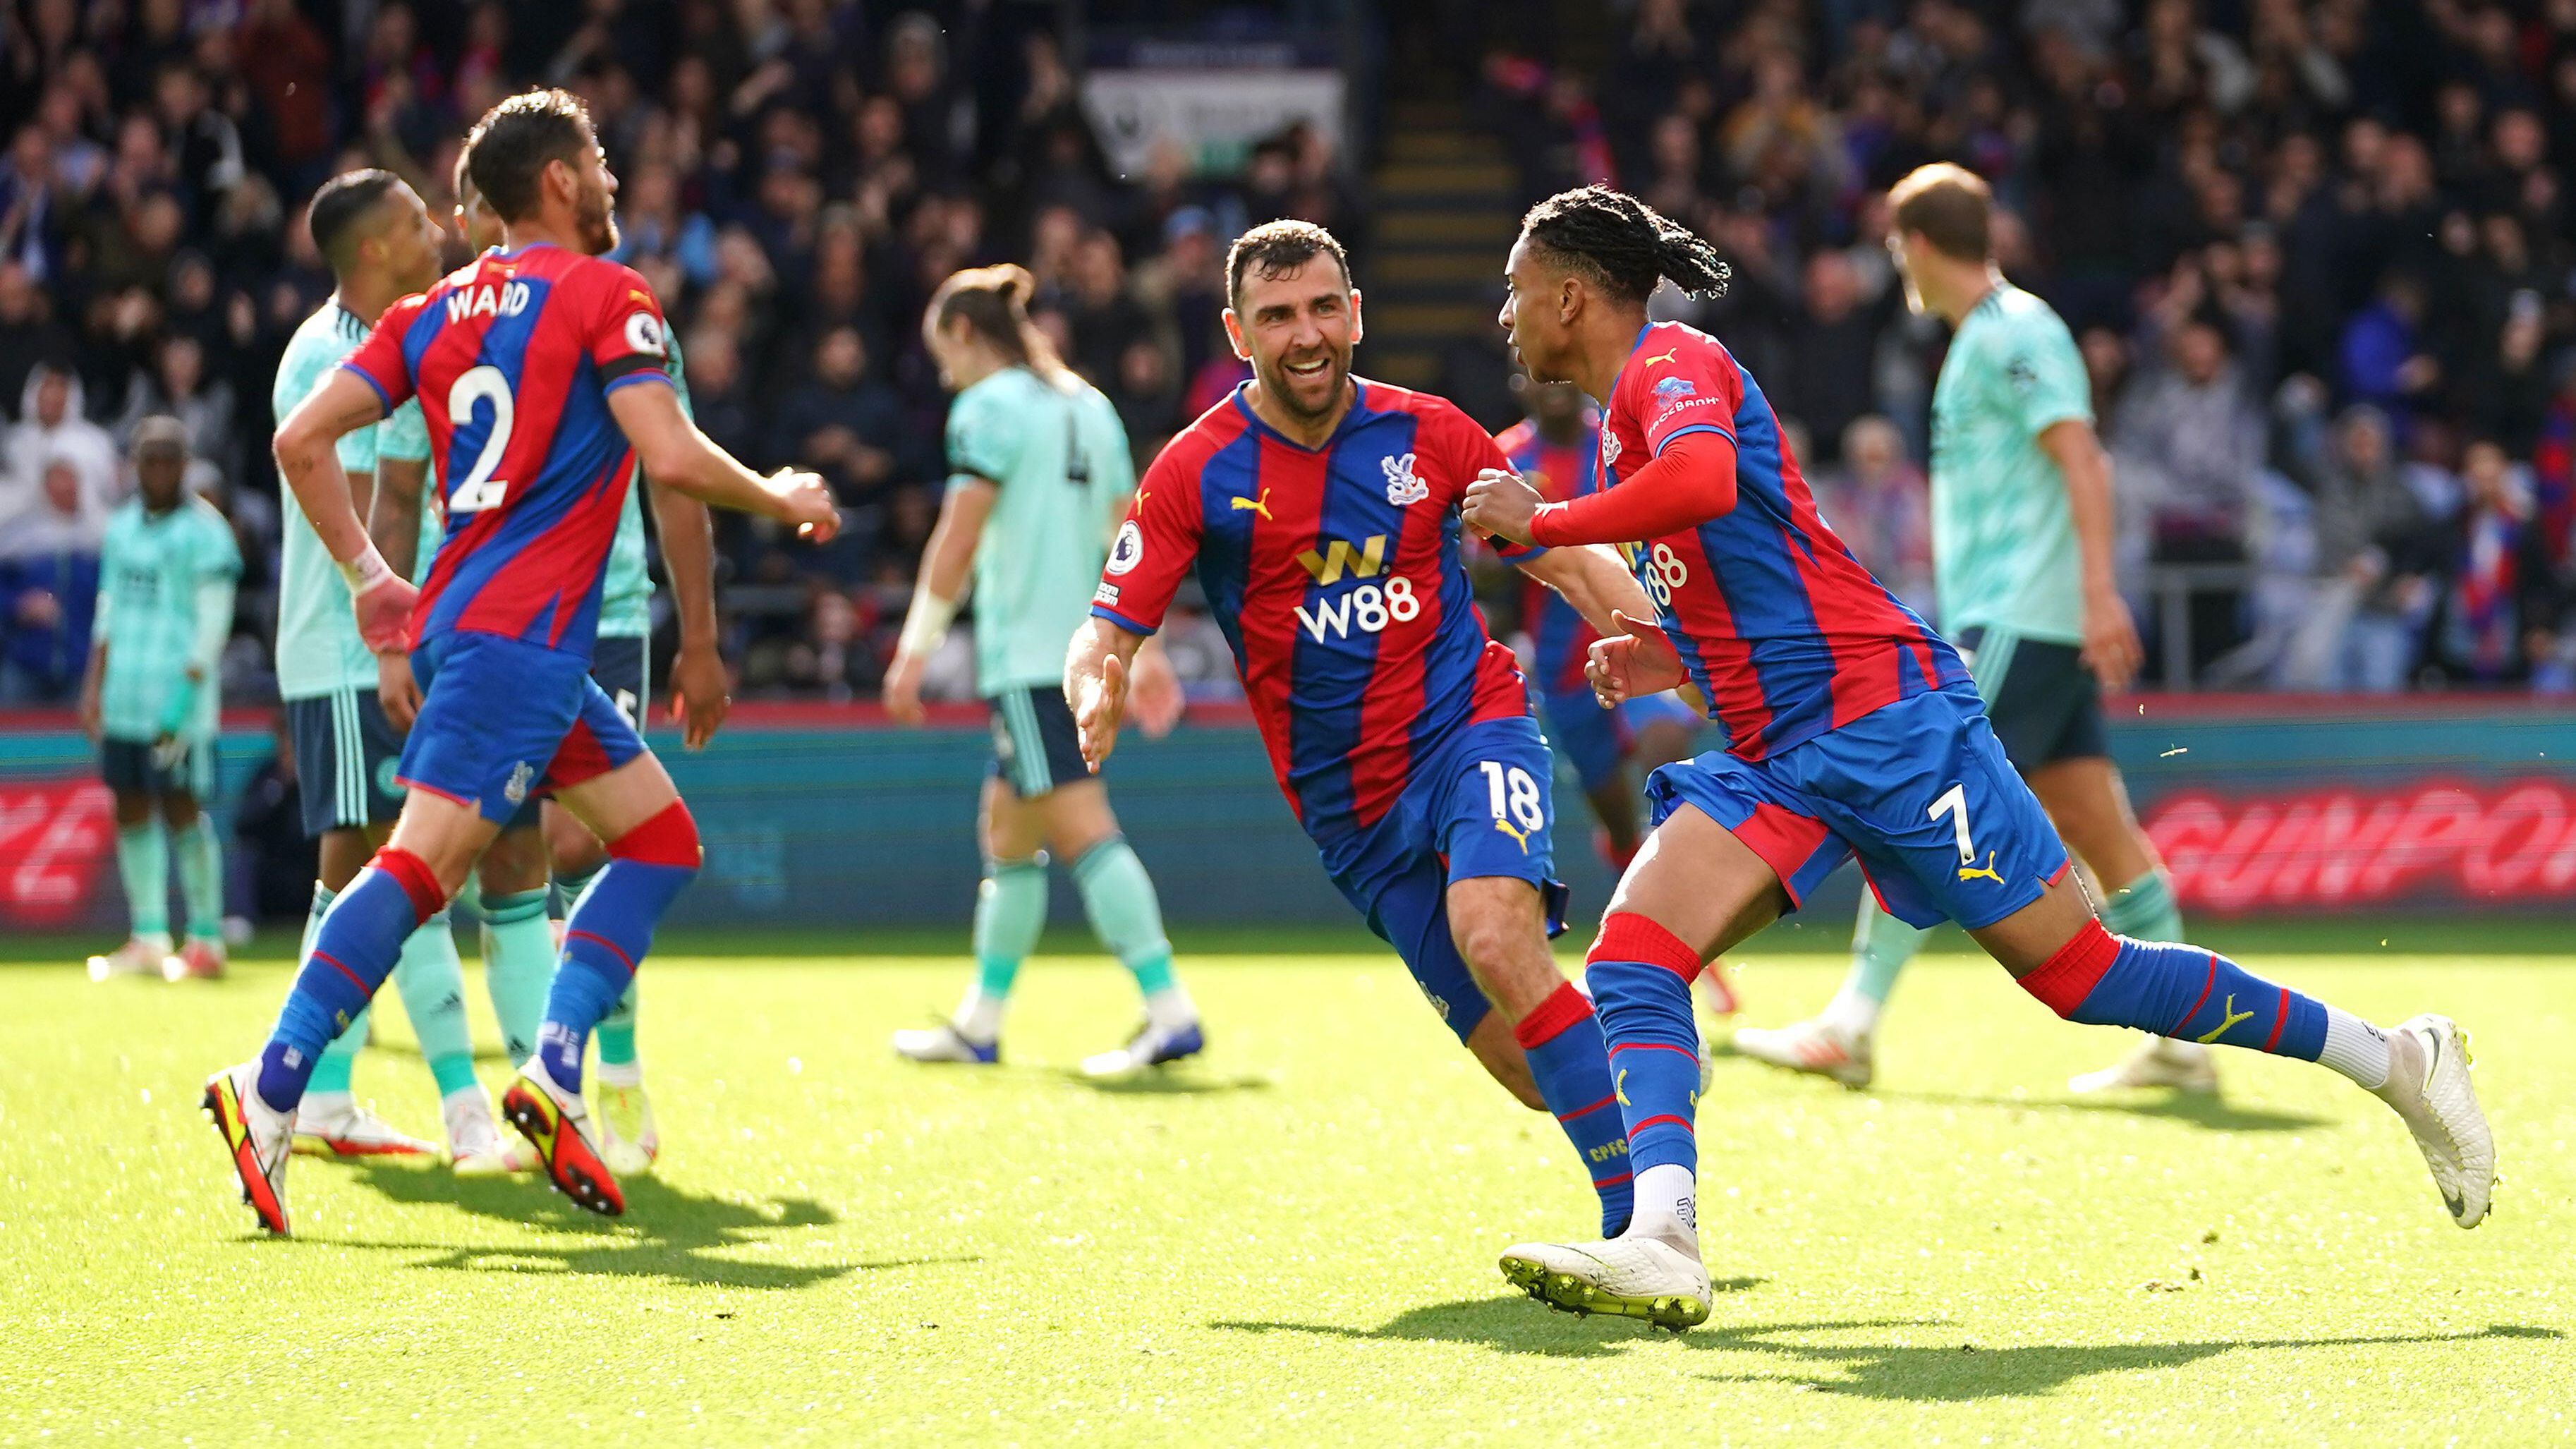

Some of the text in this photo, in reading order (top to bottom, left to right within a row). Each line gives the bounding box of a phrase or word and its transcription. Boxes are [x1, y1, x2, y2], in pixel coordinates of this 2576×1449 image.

[446, 281, 530, 325] WARD
[448, 365, 515, 513] 2
[1293, 576, 1421, 645] W88
[1480, 760, 1545, 832] 18
[1926, 783, 1976, 867] 7
[1589, 1138, 1629, 1163] CPFC
